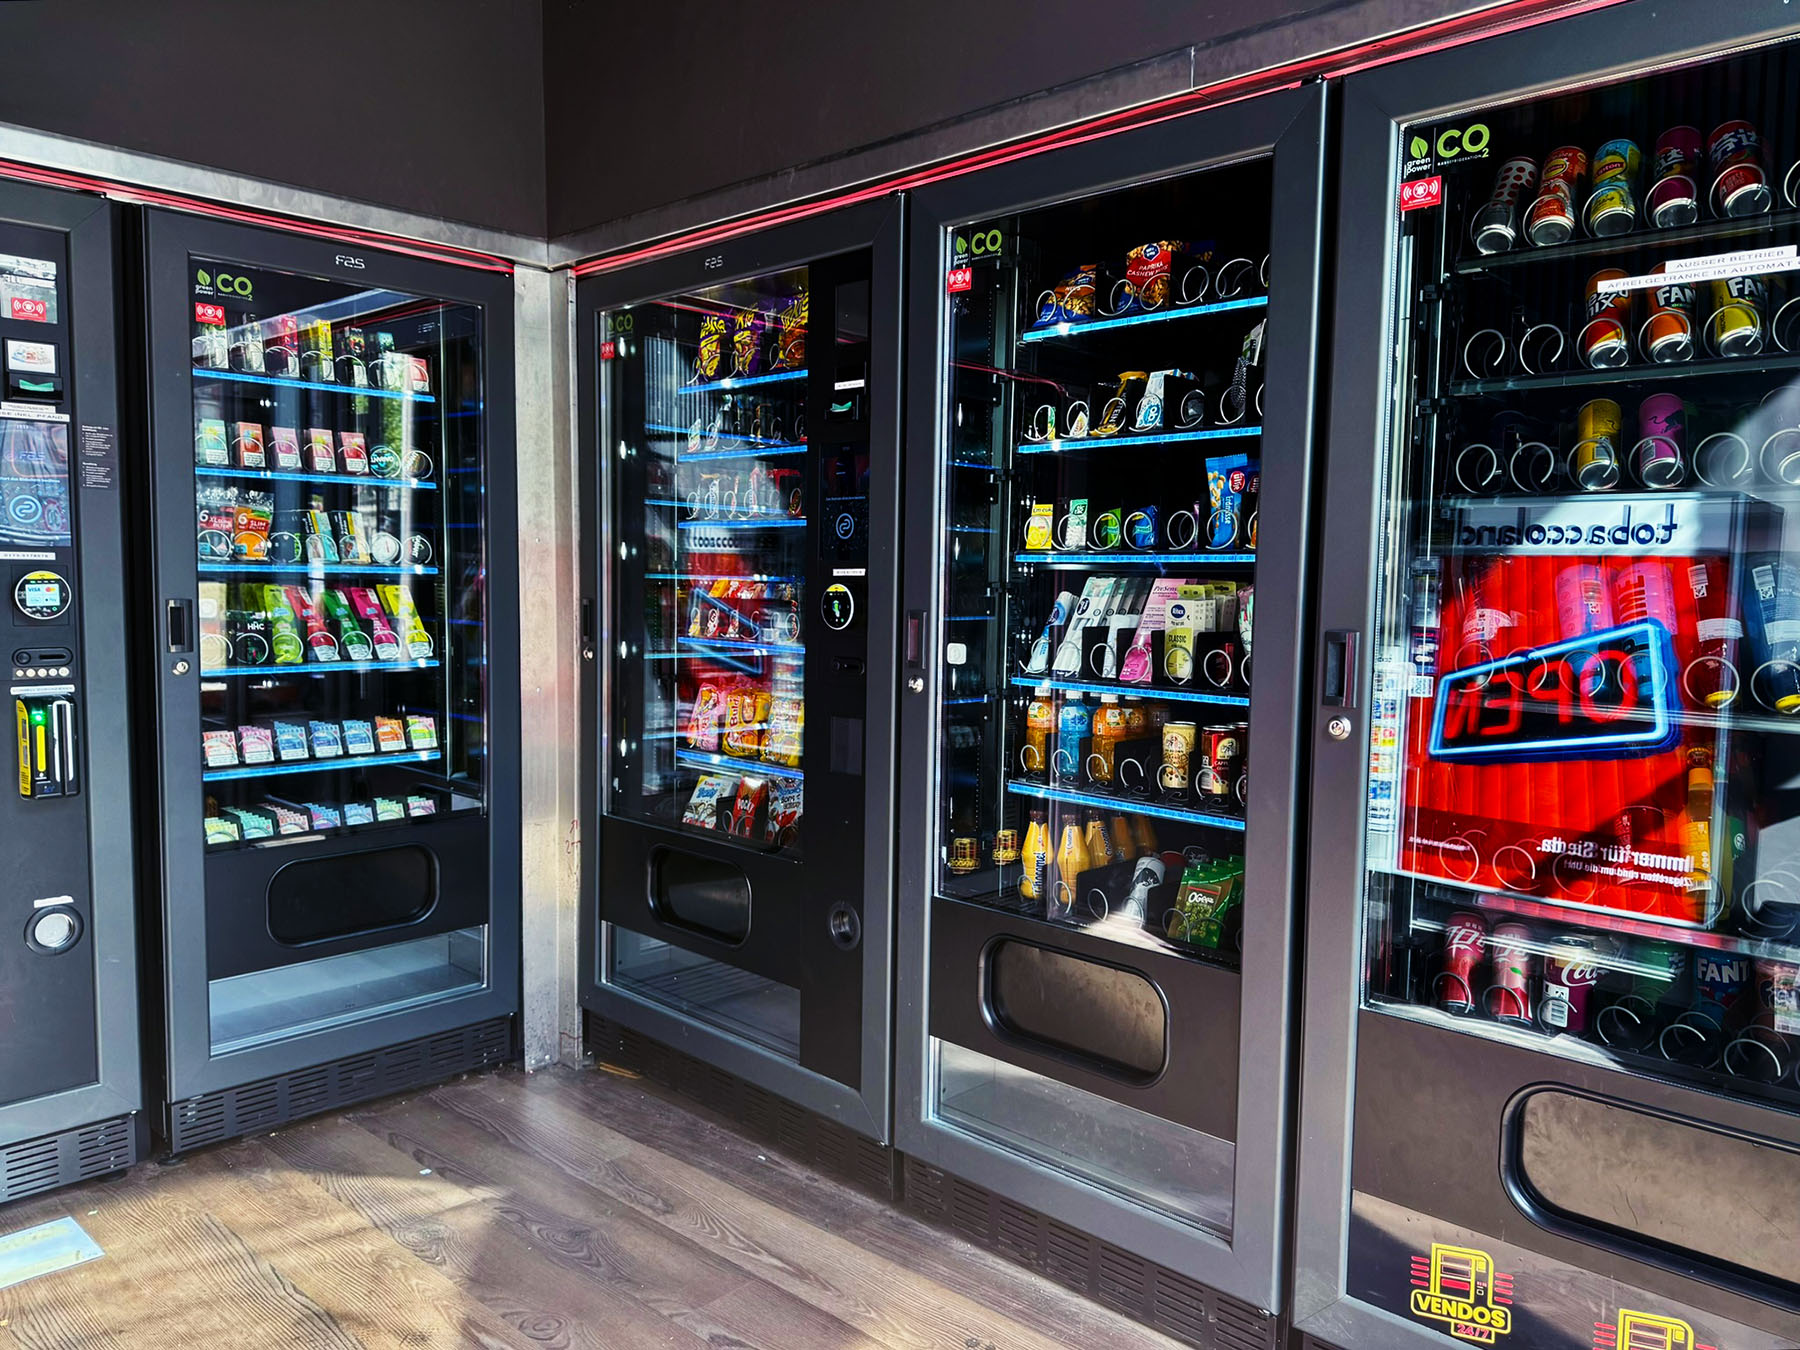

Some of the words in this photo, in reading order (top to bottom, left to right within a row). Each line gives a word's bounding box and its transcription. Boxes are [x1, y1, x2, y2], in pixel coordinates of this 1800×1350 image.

[1406, 157, 1431, 168] green
[1406, 163, 1432, 176] power
[1138, 261, 1164, 271] PAPRIKA
[1676, 256, 1726, 269] AUSSER
[1729, 250, 1785, 262] BETRIEB
[1713, 269, 1727, 279] IM
[1731, 261, 1793, 274] AUTOMAT
[200, 509, 210, 522] 6
[238, 512, 248, 525] 6
[1168, 634, 1187, 643] CLASSIC
[1415, 1292, 1506, 1329] VENDOS
[1456, 1323, 1490, 1339] 24/7
